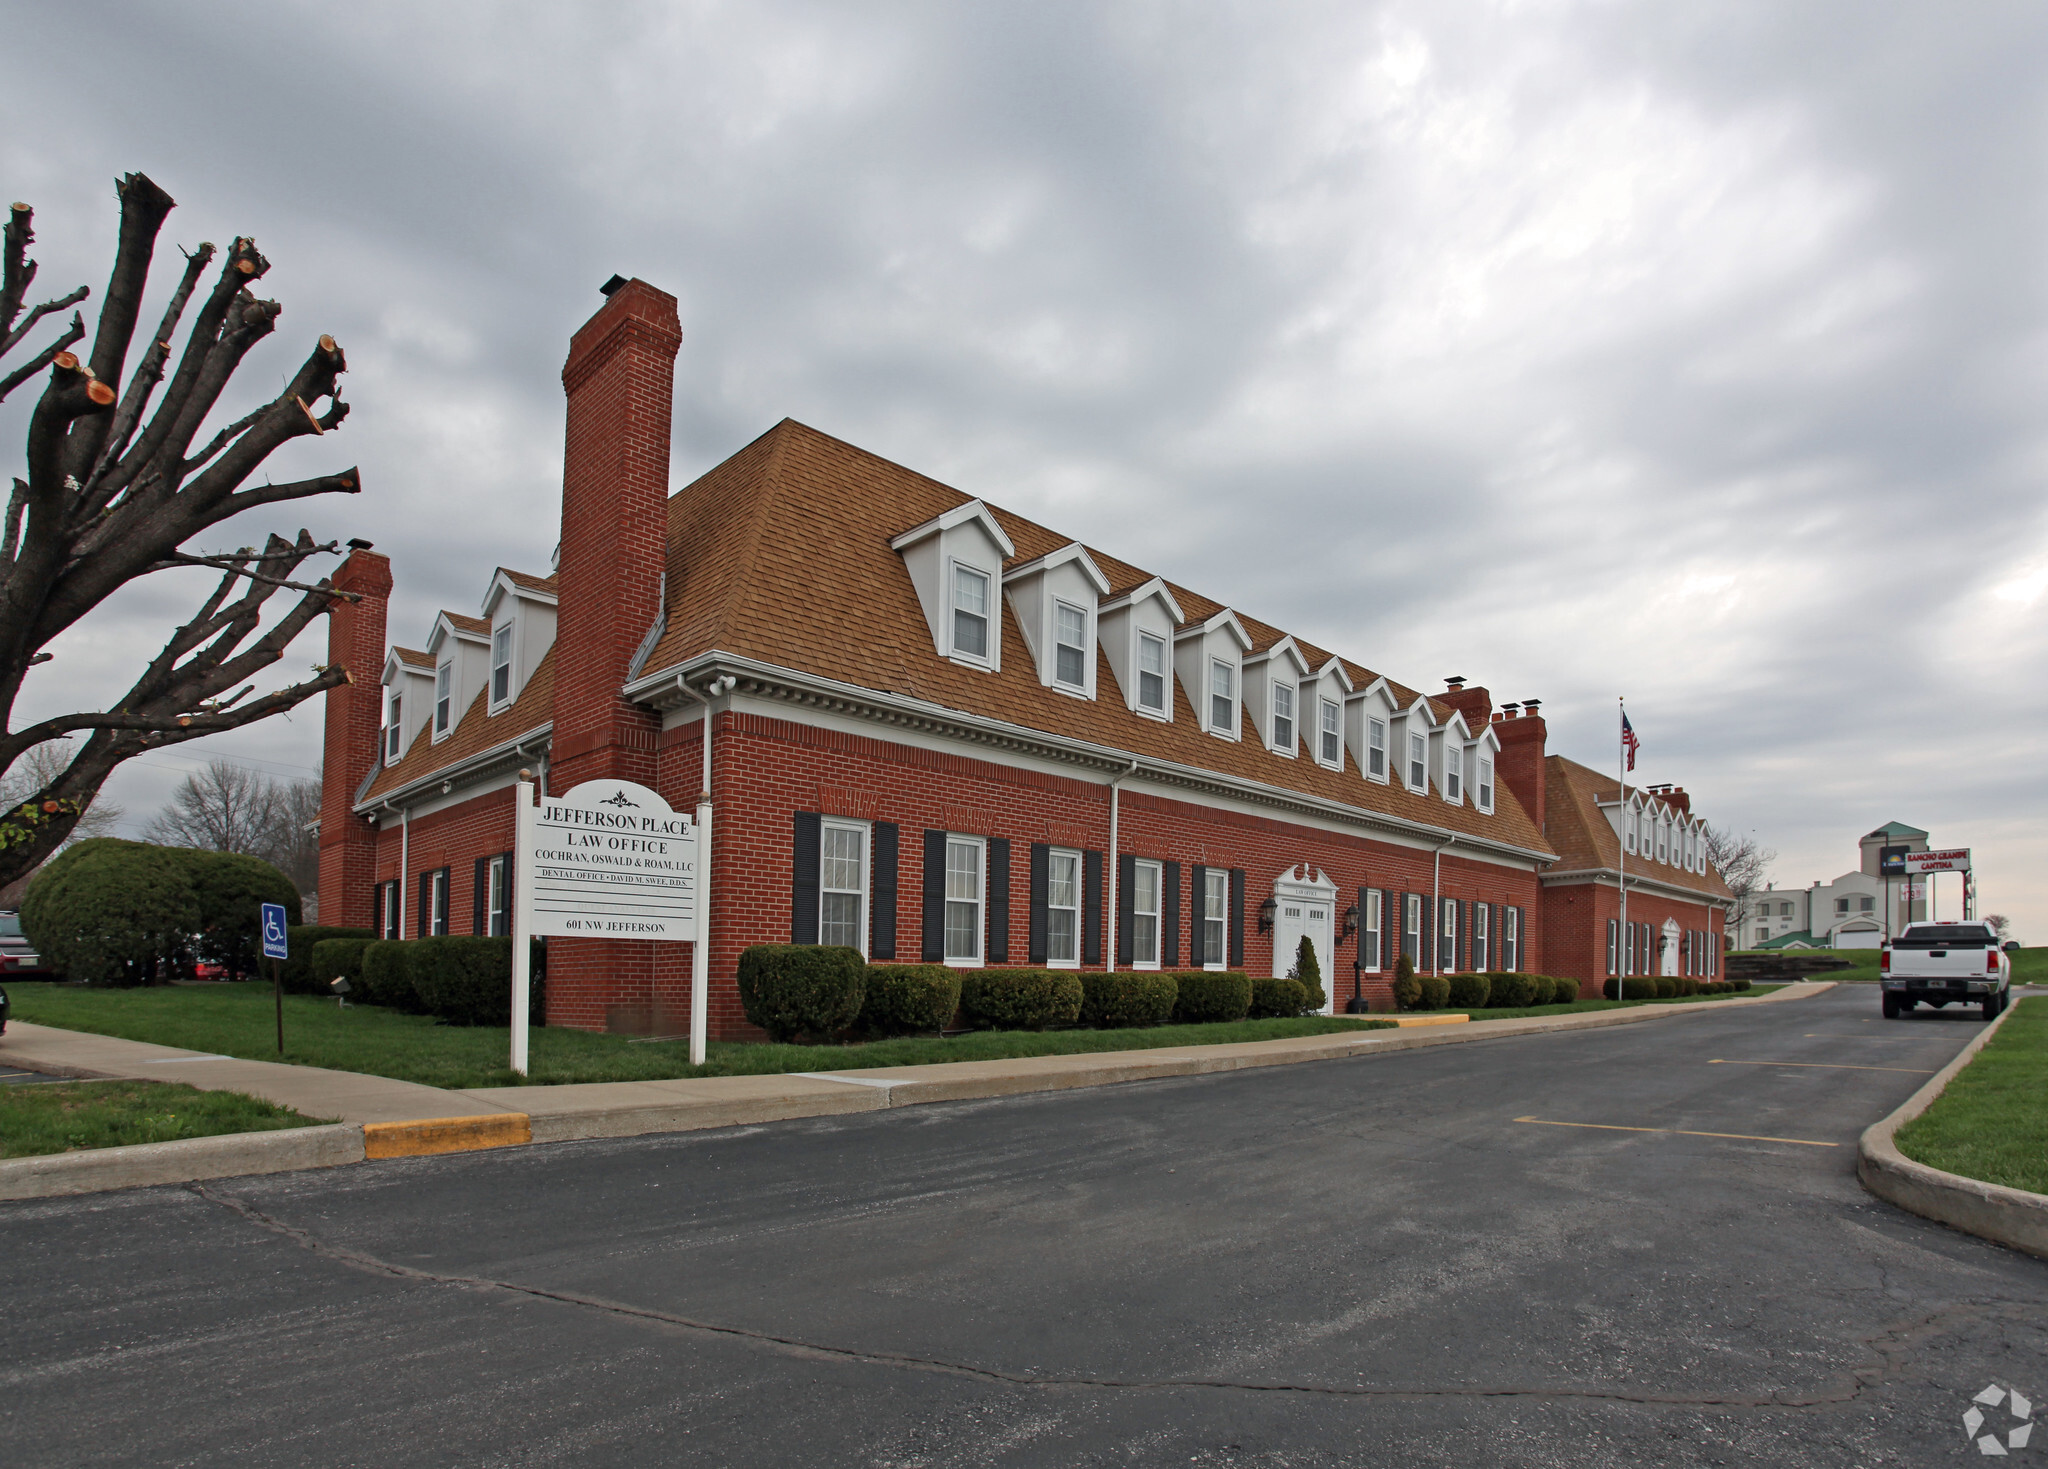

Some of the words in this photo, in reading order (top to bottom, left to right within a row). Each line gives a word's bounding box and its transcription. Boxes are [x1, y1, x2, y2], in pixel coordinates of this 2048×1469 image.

[543, 806, 637, 830] JEFFERSON
[641, 817, 690, 835] PLACE
[567, 832, 604, 847] LAW
[608, 837, 668, 854] OFFICE
[535, 849, 590, 864] COCHRAN,
[591, 854, 632, 867] OSWALD
[634, 858, 642, 867] &
[644, 859, 674, 871] ROAM,
[676, 861, 694, 872] LLC
[1907, 853, 1937, 862] RANCHO
[1938, 851, 1967, 860] GRANDE
[1921, 861, 1953, 870] CANTINA
[542, 869, 575, 878] DENTAL
[576, 871, 605, 881] OFFICE
[610, 874, 634, 883] DAVID
[635, 876, 644, 884] M.
[645, 877, 668, 886] SWEE,
[669, 879, 688, 887] D.D.S.
[566, 920, 581, 929] 601
[585, 921, 604, 930] NW
[605, 922, 665, 933] JEFFERSON
[265, 943, 286, 953] PARKING
